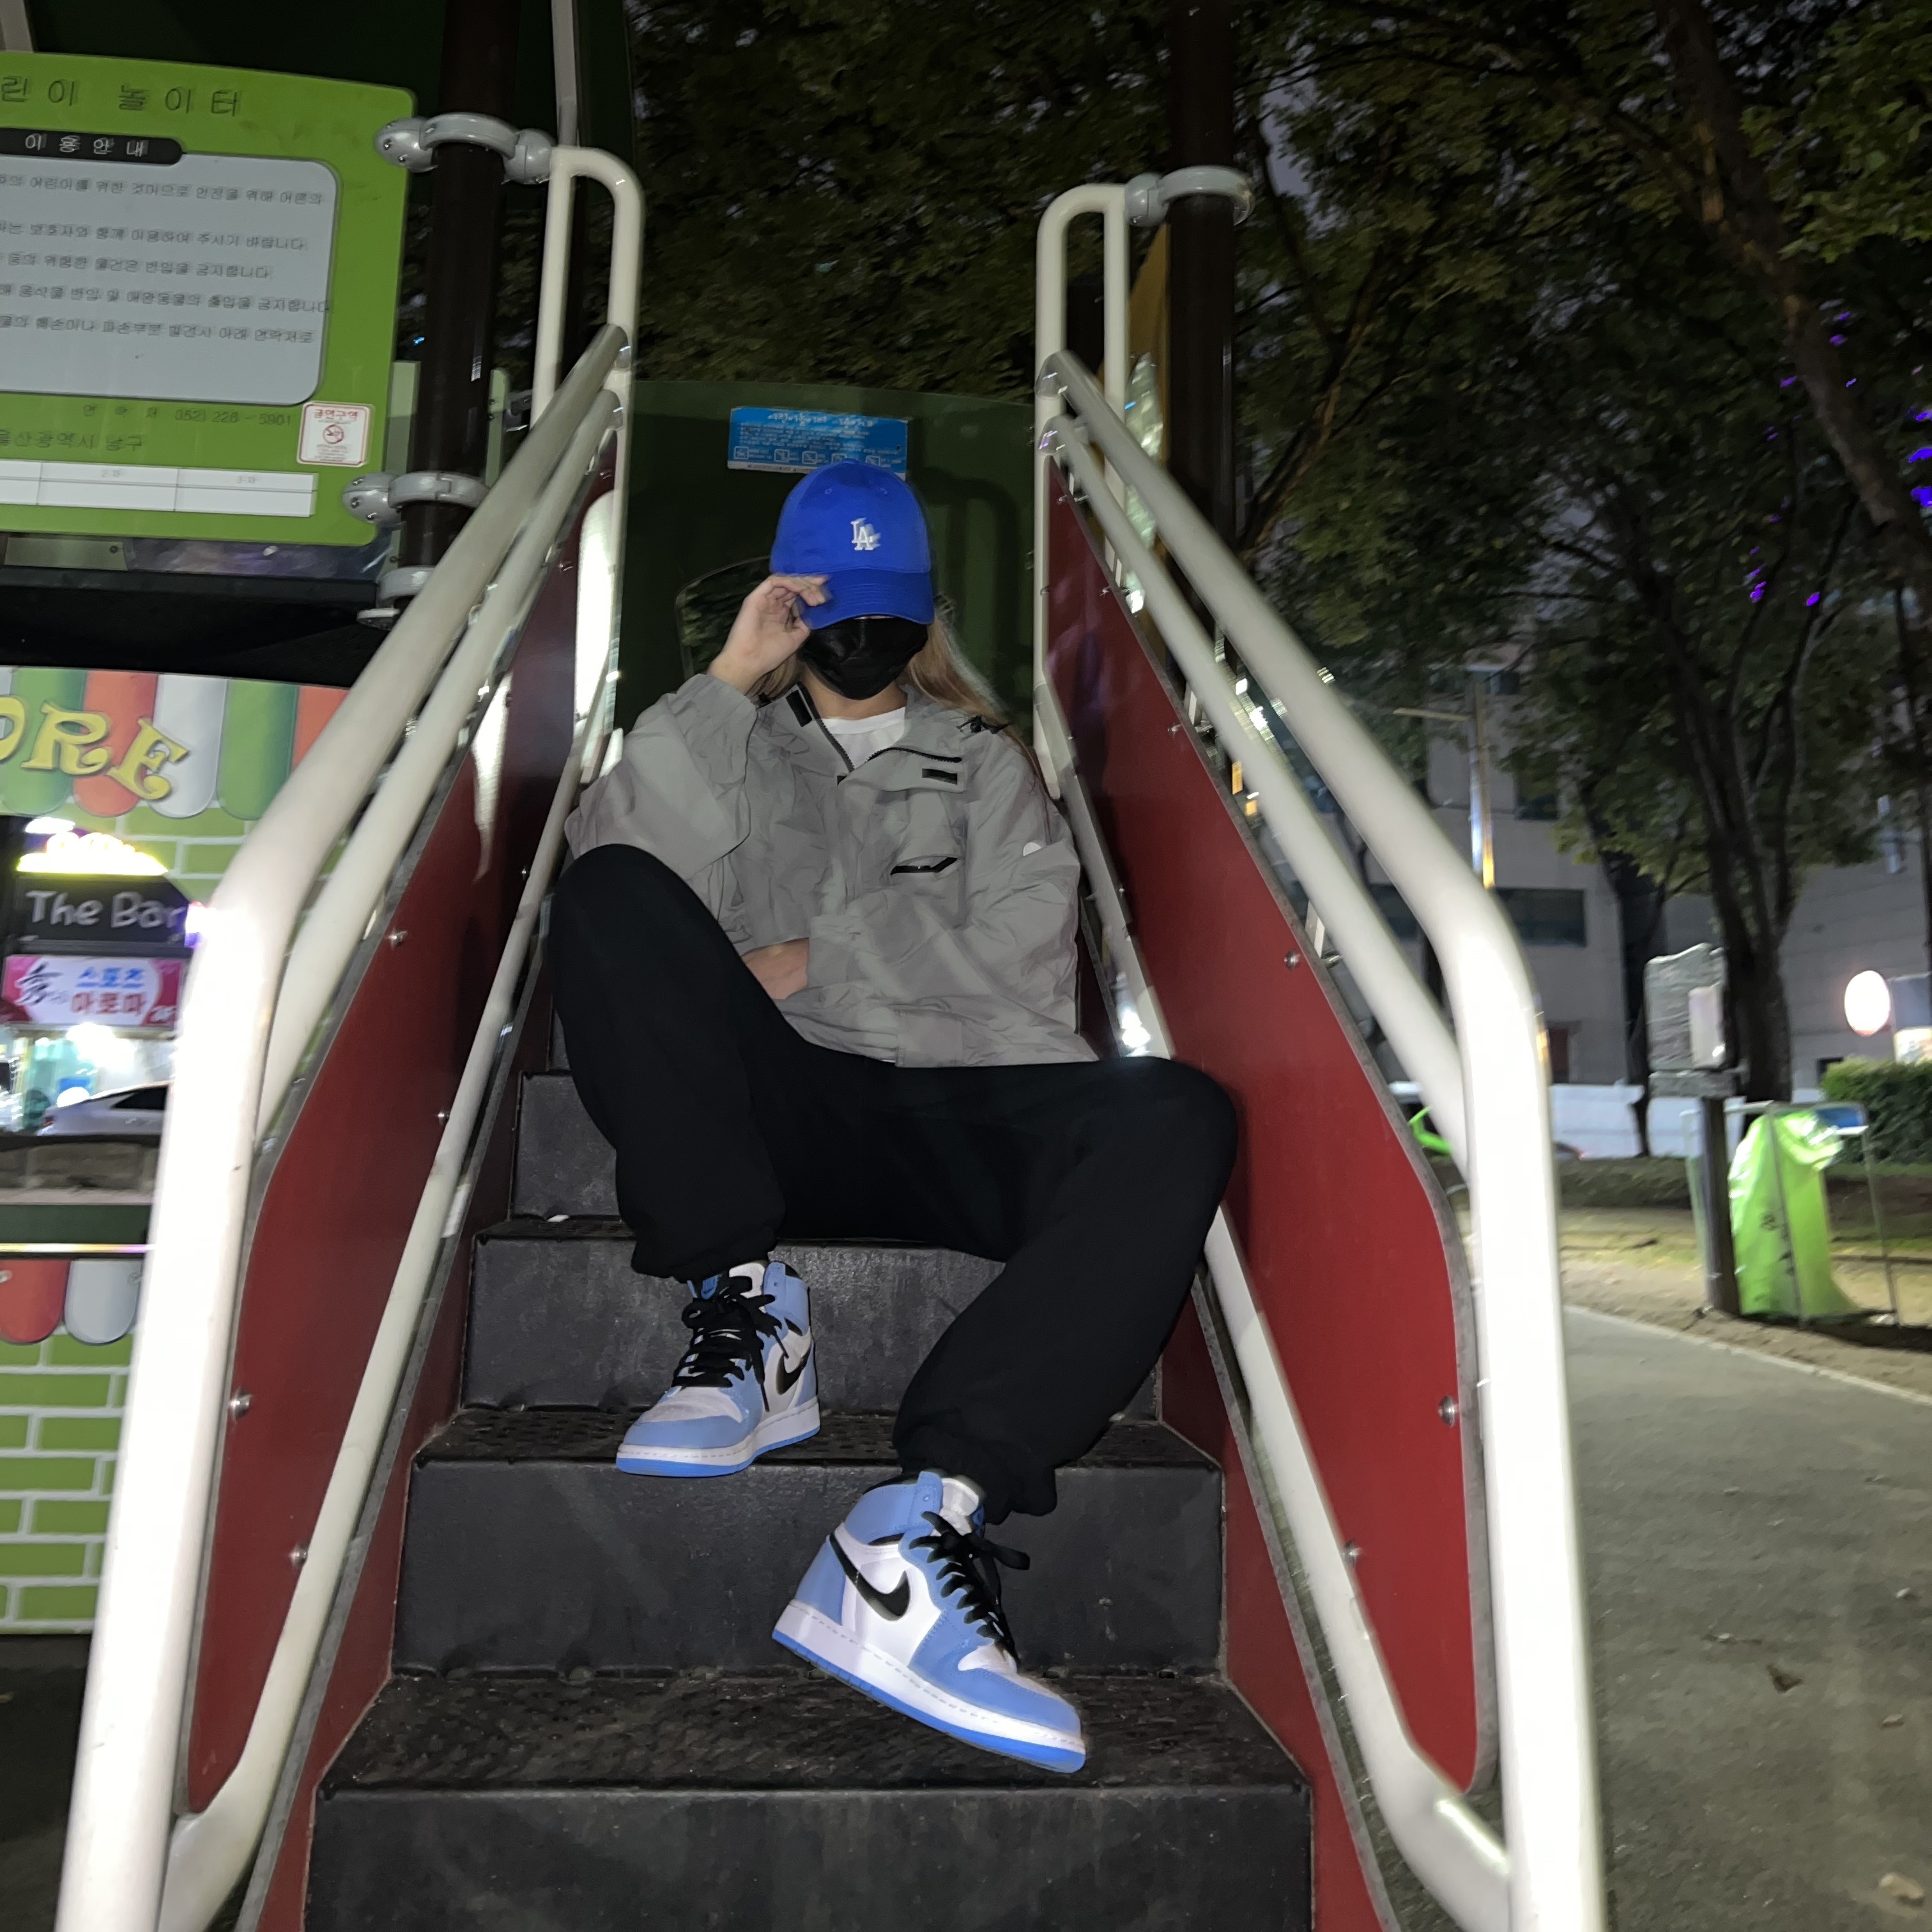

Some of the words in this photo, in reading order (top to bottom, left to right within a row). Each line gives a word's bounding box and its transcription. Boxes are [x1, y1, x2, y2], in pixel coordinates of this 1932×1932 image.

[119, 84, 240, 117] 놀이터
[25, 133, 148, 157] 이용안내
[197, 234, 239, 247] 주시기
[219, 327, 247, 341] 아래
[850, 518, 881, 551] LA
[26, 890, 103, 926] The
[111, 891, 187, 929] Bar
